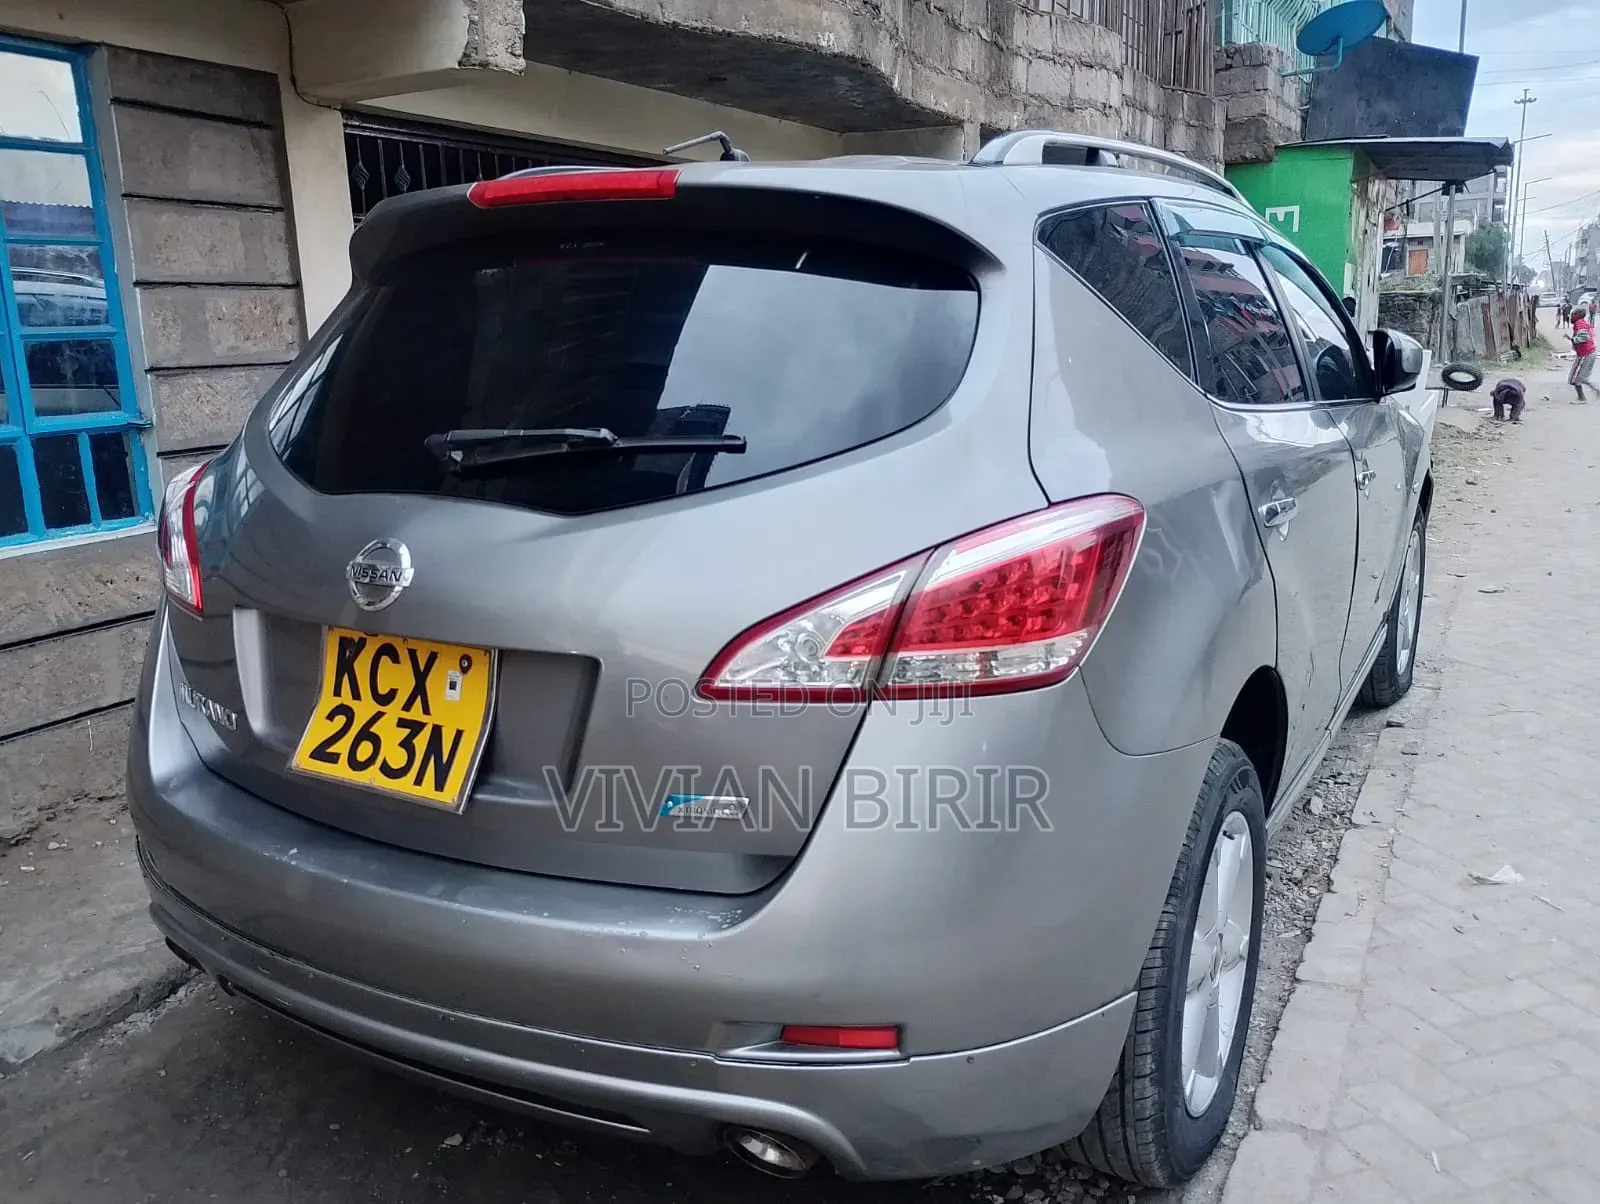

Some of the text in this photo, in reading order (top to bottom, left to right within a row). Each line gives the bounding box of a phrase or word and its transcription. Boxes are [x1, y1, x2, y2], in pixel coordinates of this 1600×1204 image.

[349, 564, 403, 583] NISSAN
[332, 635, 440, 716] KCX
[308, 702, 465, 793] 263N
